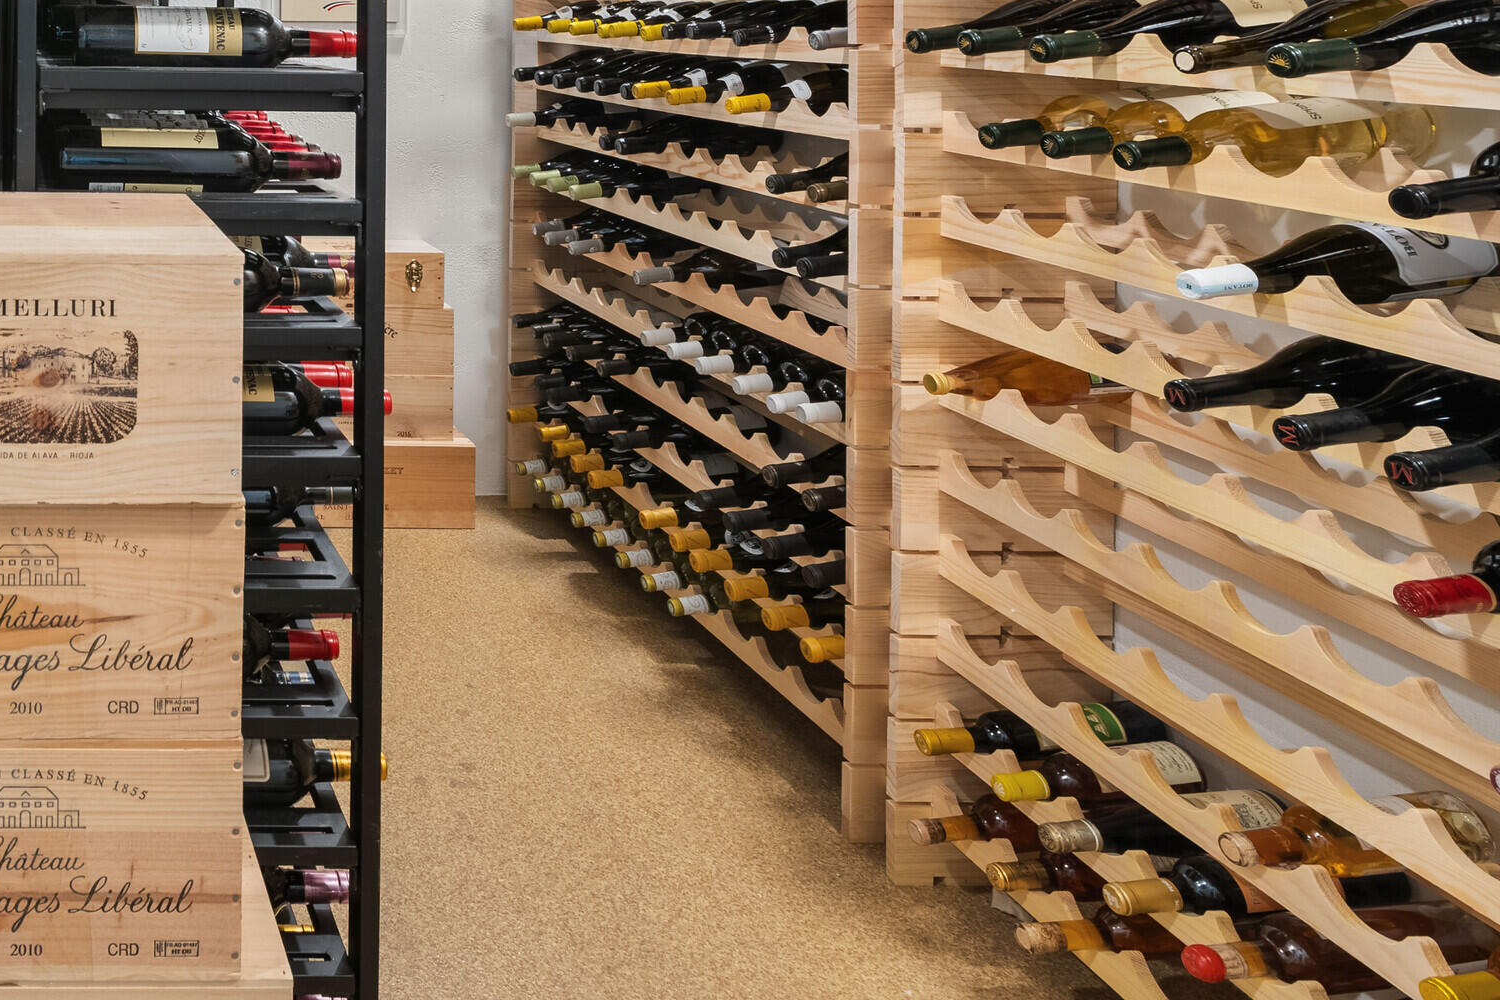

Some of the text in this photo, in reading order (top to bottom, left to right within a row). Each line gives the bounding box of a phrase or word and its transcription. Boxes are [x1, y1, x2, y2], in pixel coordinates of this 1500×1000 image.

[17, 451, 28, 460] DE
[69, 451, 95, 460] RIOJA
[10, 526, 77, 540] CLASSÉ
[83, 532, 107, 547] EN
[112, 538, 149, 559] 1855
[68, 633, 193, 672] Libéral
[9, 701, 43, 715] 2010
[107, 700, 140, 715] CRD
[10, 768, 77, 782] CLASSÉ
[83, 773, 107, 788] EN
[111, 779, 149, 801] 1855
[68, 875, 194, 915] Libéral
[9, 943, 43, 957] 2010
[107, 943, 140, 957] CRD
